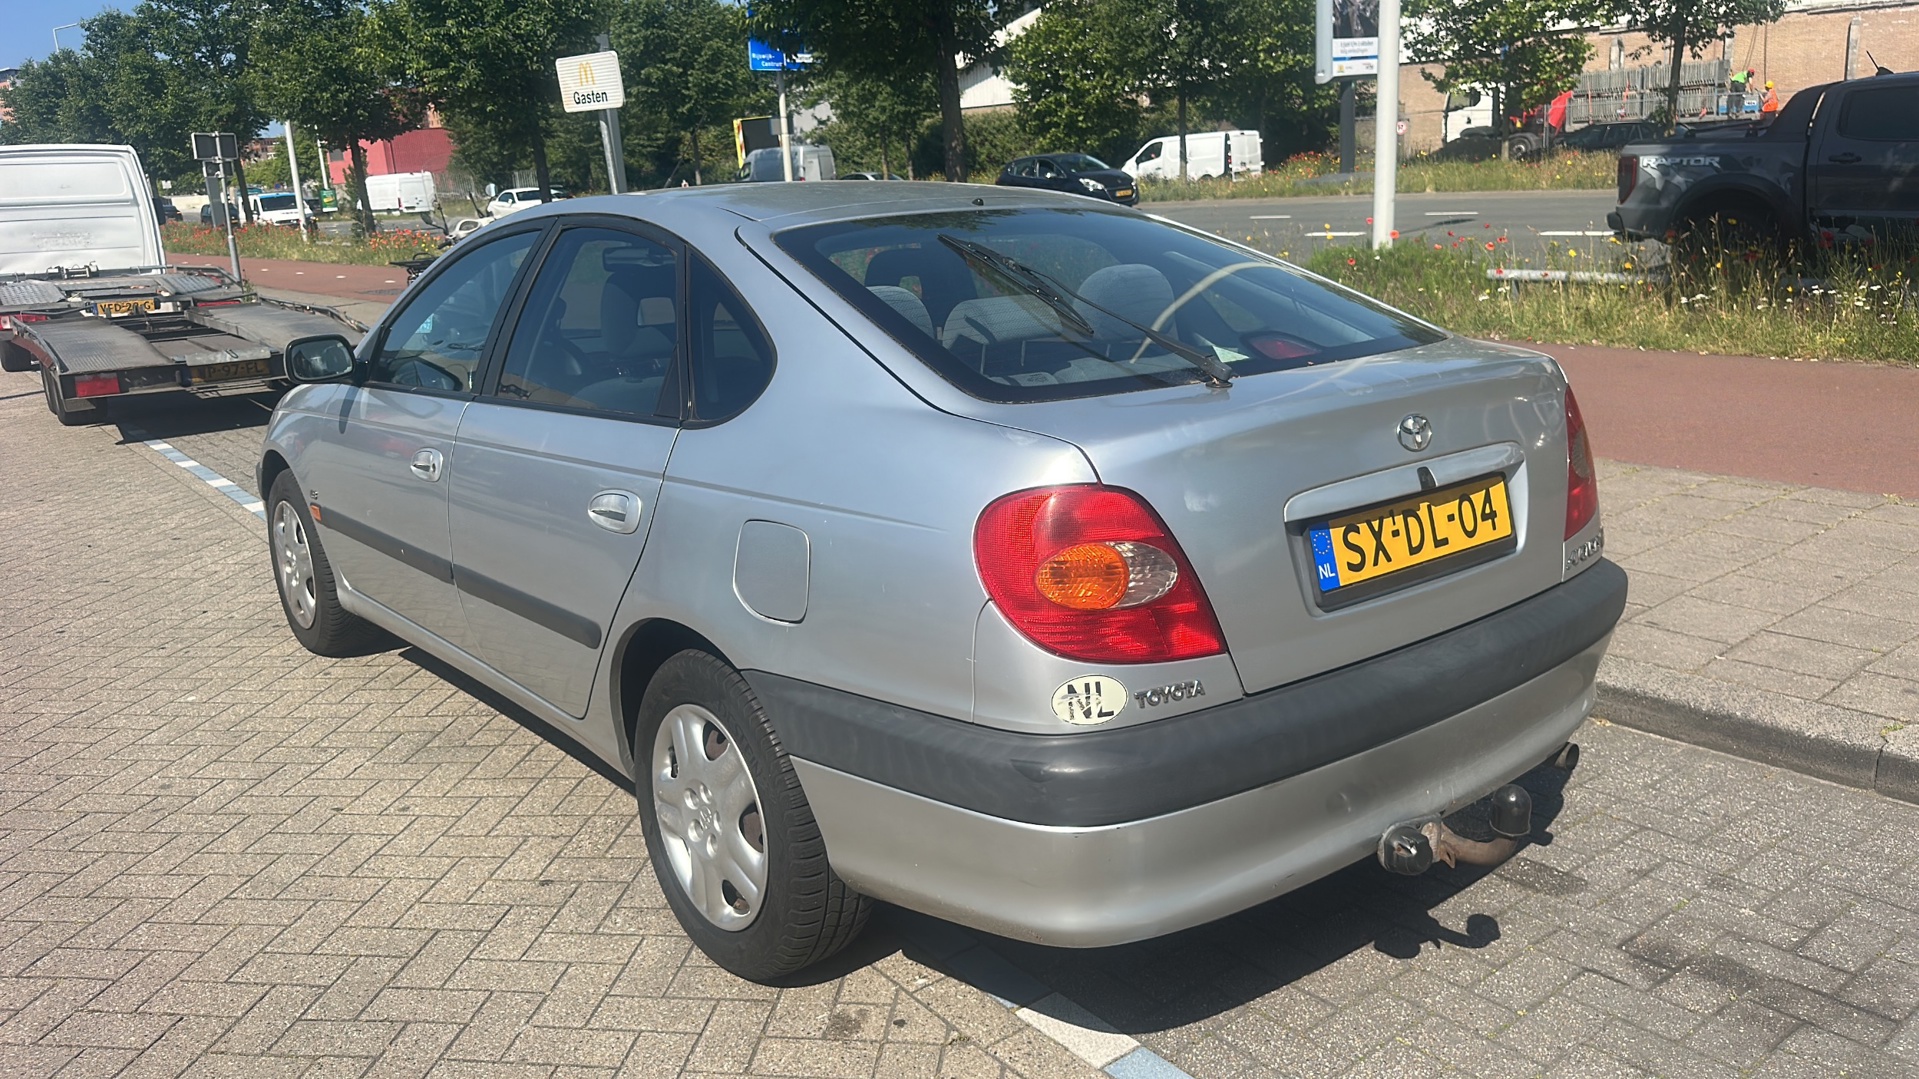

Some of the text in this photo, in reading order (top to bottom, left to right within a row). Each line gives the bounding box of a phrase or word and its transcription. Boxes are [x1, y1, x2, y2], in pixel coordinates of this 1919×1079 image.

[573, 90, 608, 105] Gasten
[1640, 155, 1721, 170] RAPTOR
[1342, 487, 1498, 573] SX-DL-04
[1318, 562, 1336, 580] NL
[1067, 681, 1115, 719] NL
[1133, 678, 1206, 709] TOYOTA
